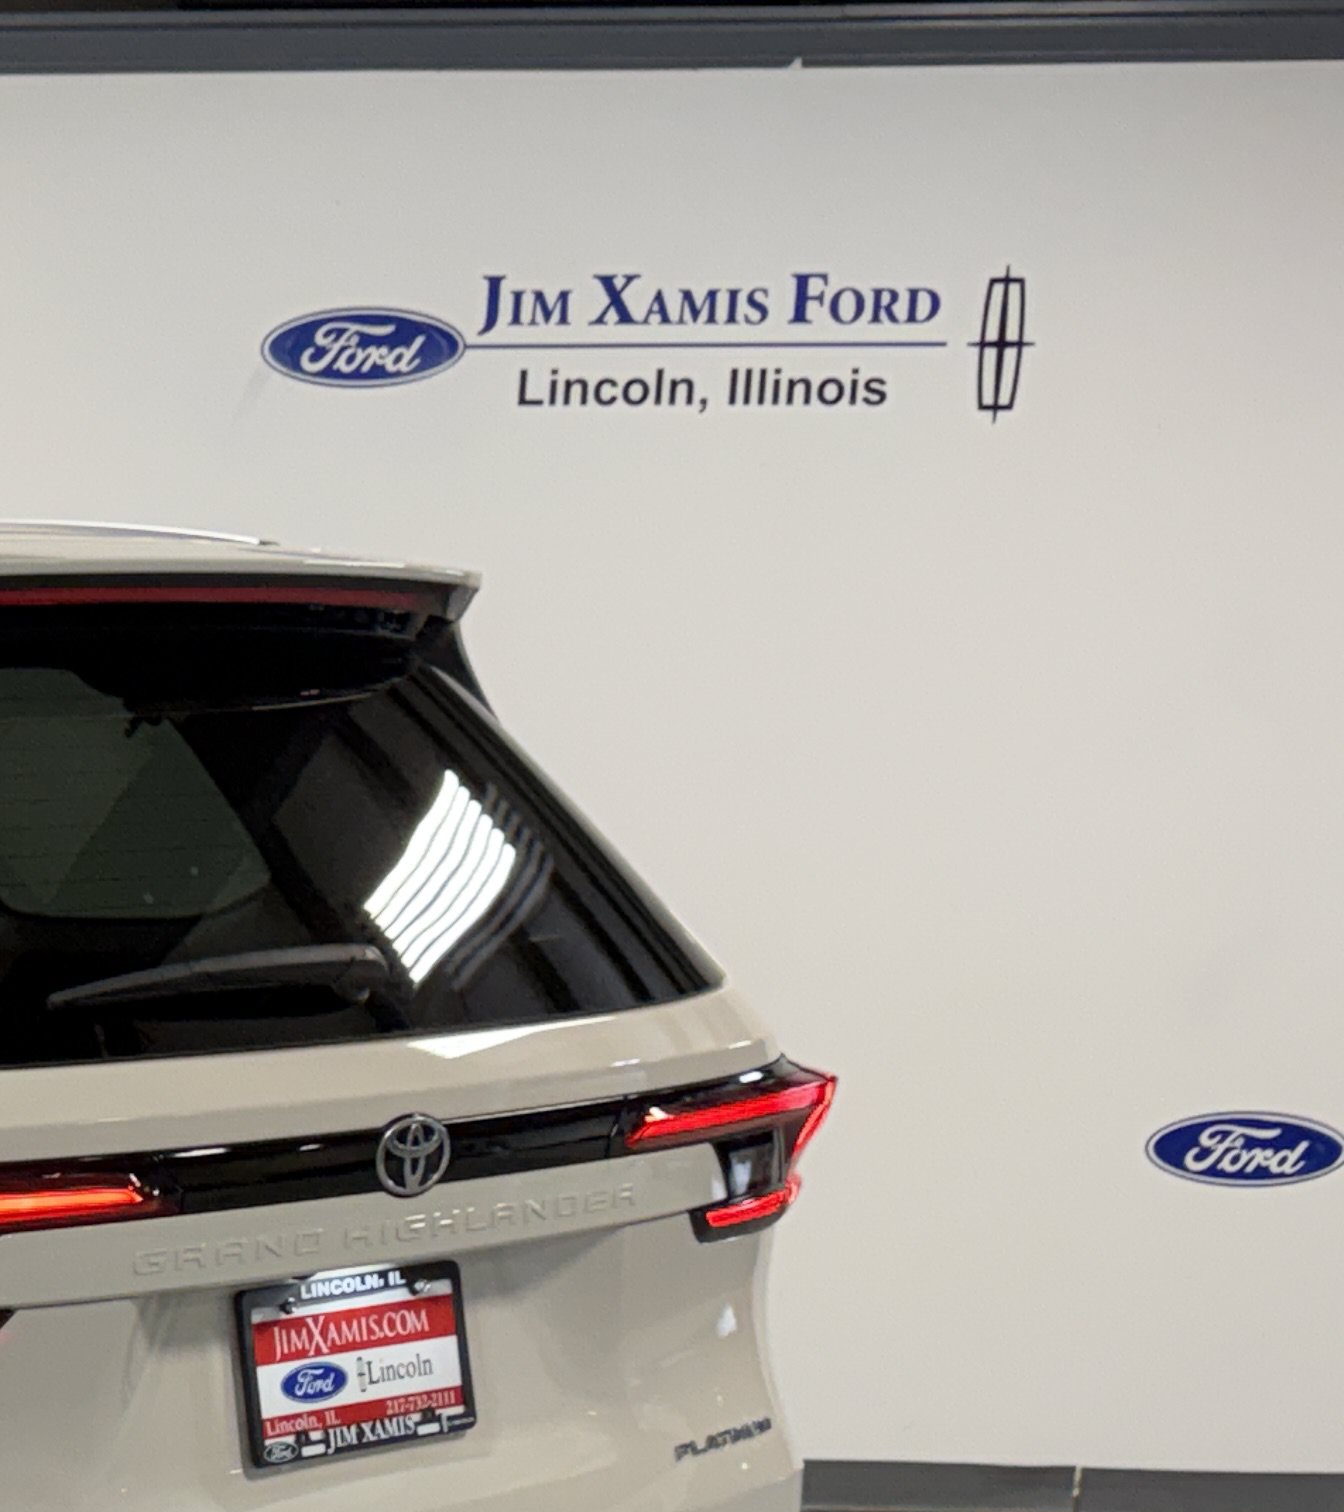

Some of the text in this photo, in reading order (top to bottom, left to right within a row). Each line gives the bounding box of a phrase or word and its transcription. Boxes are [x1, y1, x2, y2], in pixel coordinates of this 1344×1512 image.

[477, 272, 942, 336] JIM XAMIS FORD
[300, 321, 426, 374] Ford
[517, 367, 888, 414] Lincoln, Illinois
[1184, 1123, 1311, 1175] Ford
[131, 1182, 637, 1277] GRAND HIGHLANDER
[388, 1270, 406, 1286] IL
[272, 1308, 430, 1361] JIMXAMIS.COM
[294, 1368, 335, 1396] Ford
[366, 1353, 434, 1386] Lincoln
[327, 1426, 358, 1455] JIM
[362, 1416, 416, 1443] XAMIS
